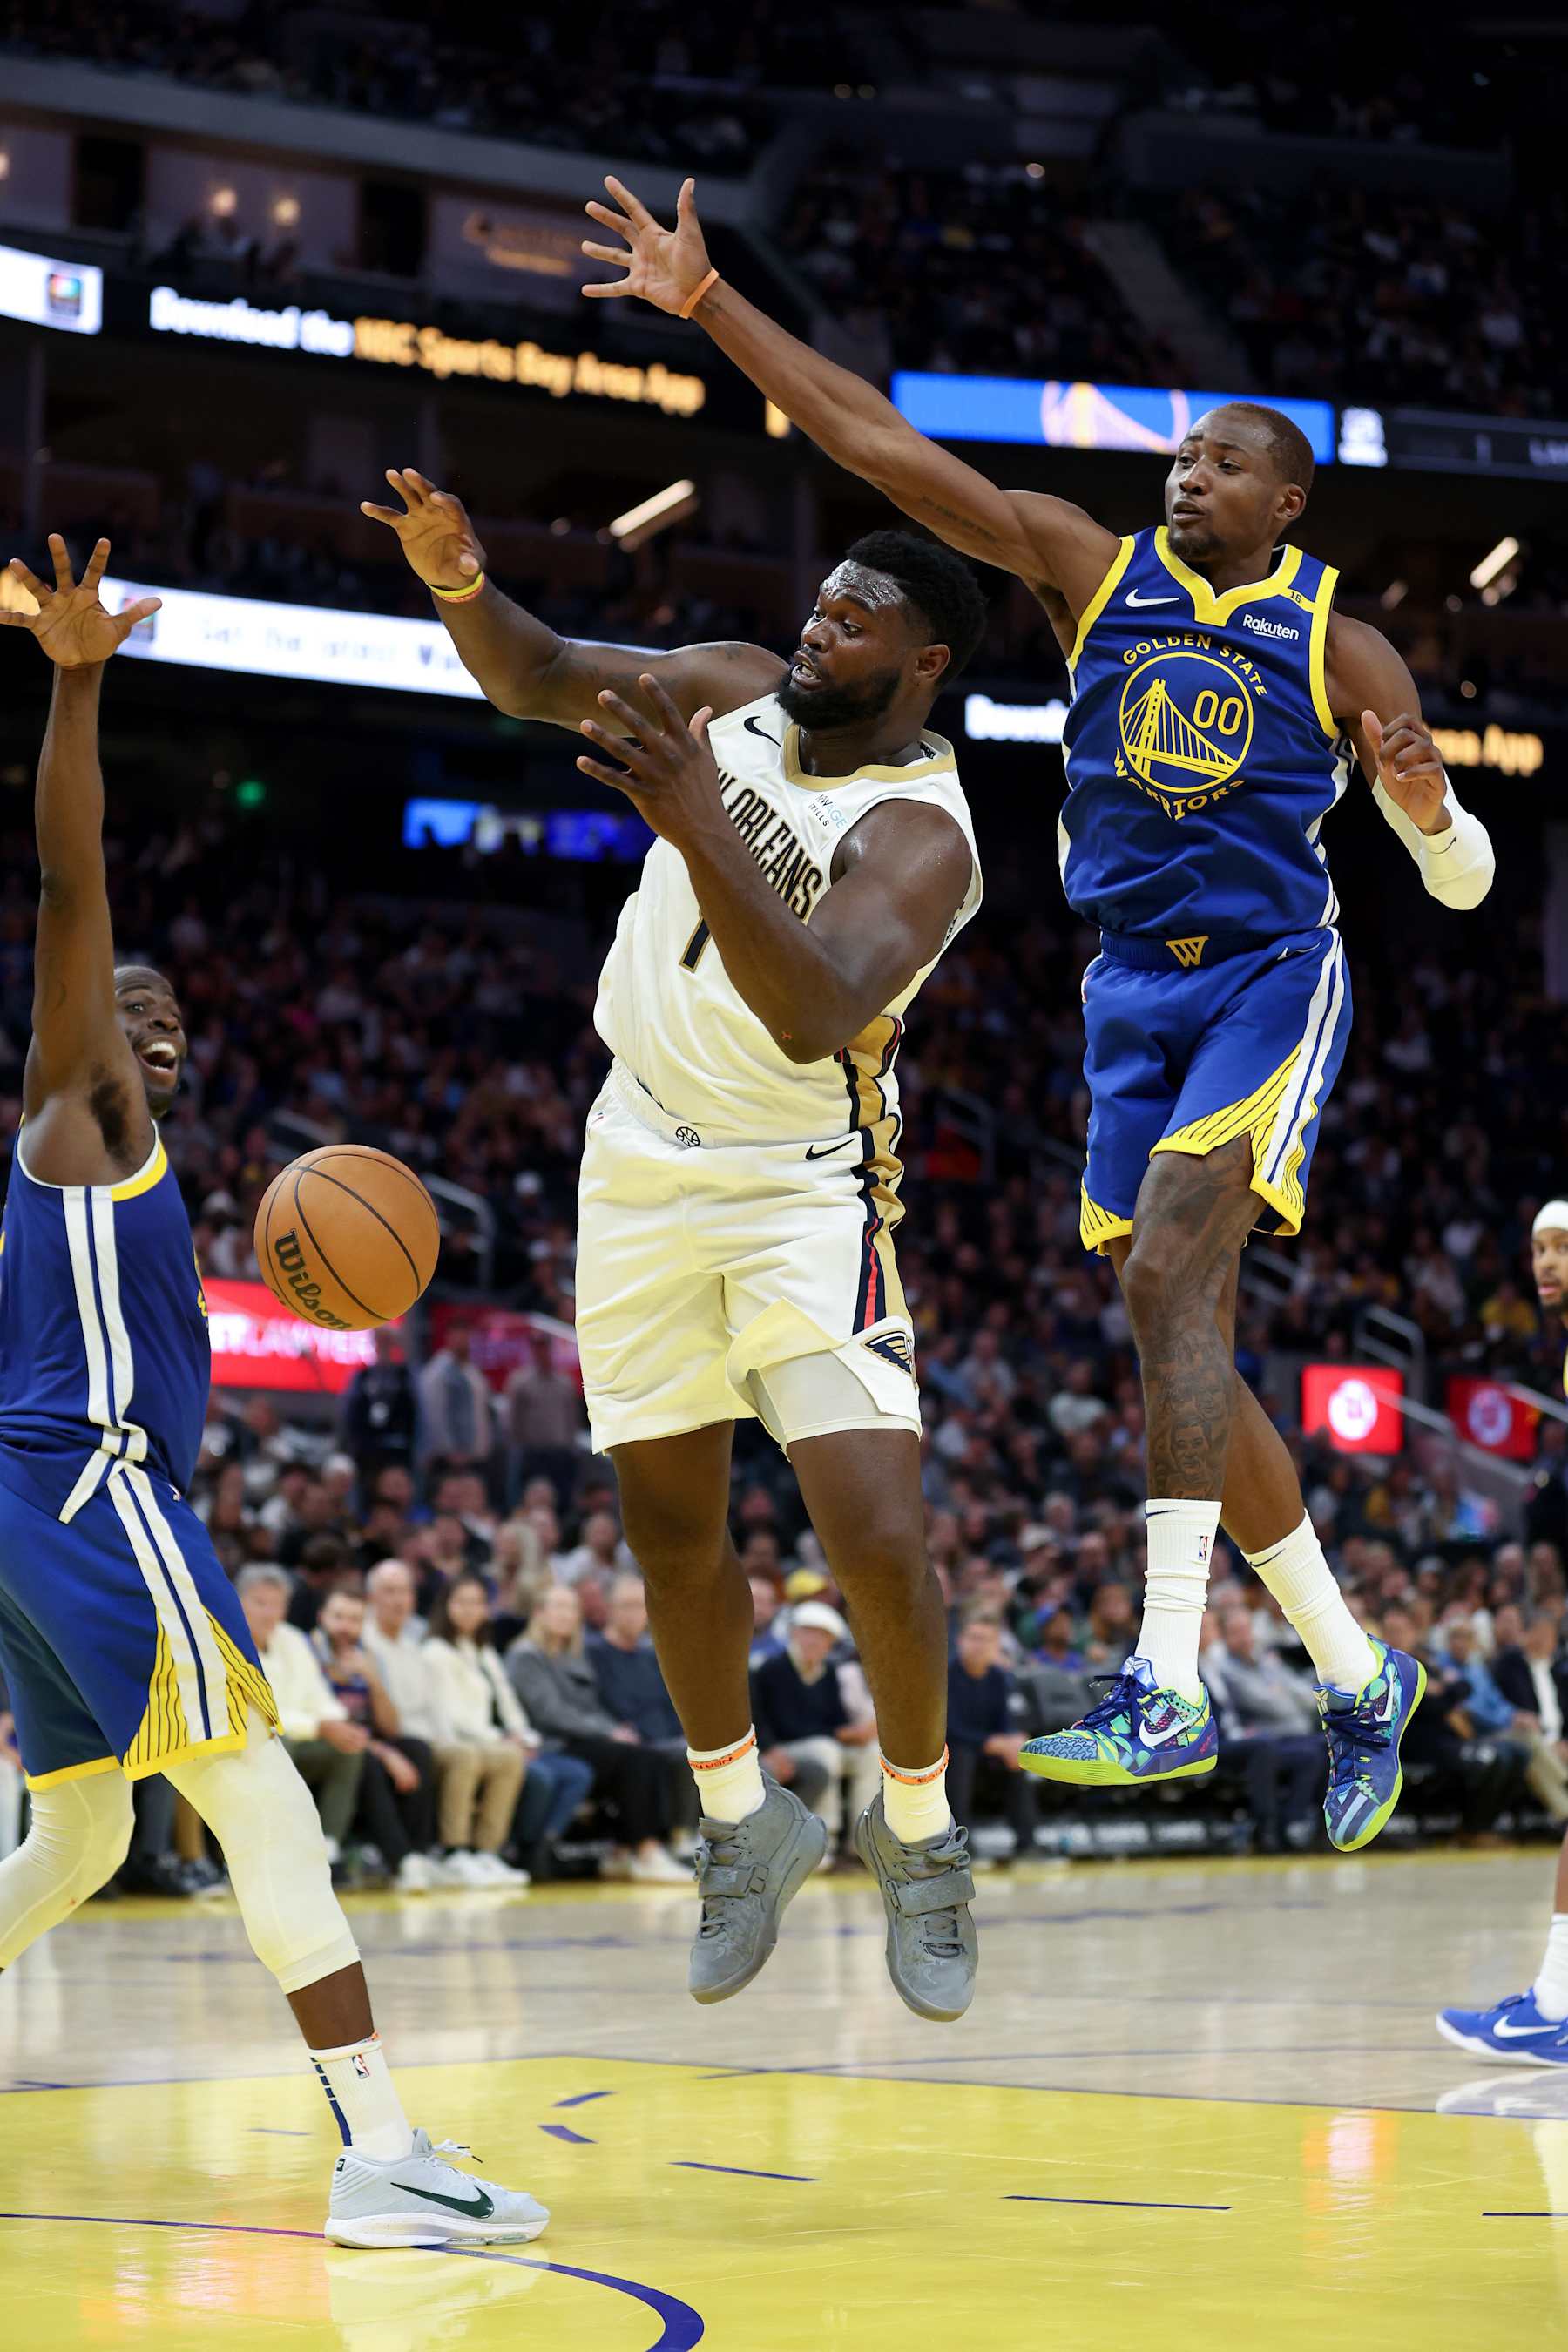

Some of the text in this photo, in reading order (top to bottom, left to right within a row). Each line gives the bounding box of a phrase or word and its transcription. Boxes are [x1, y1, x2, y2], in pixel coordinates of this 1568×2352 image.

[1290, 591, 1302, 604] 16
[1242, 613, 1300, 641] Rakuten
[1123, 634, 1268, 697] GOLDEN STATE
[1193, 689, 1245, 736] 00
[1482, 723, 1544, 777] App
[1114, 747, 1246, 821] WARRIORS
[727, 787, 825, 923] ORLEANS
[274, 1227, 353, 1330] Wilson
